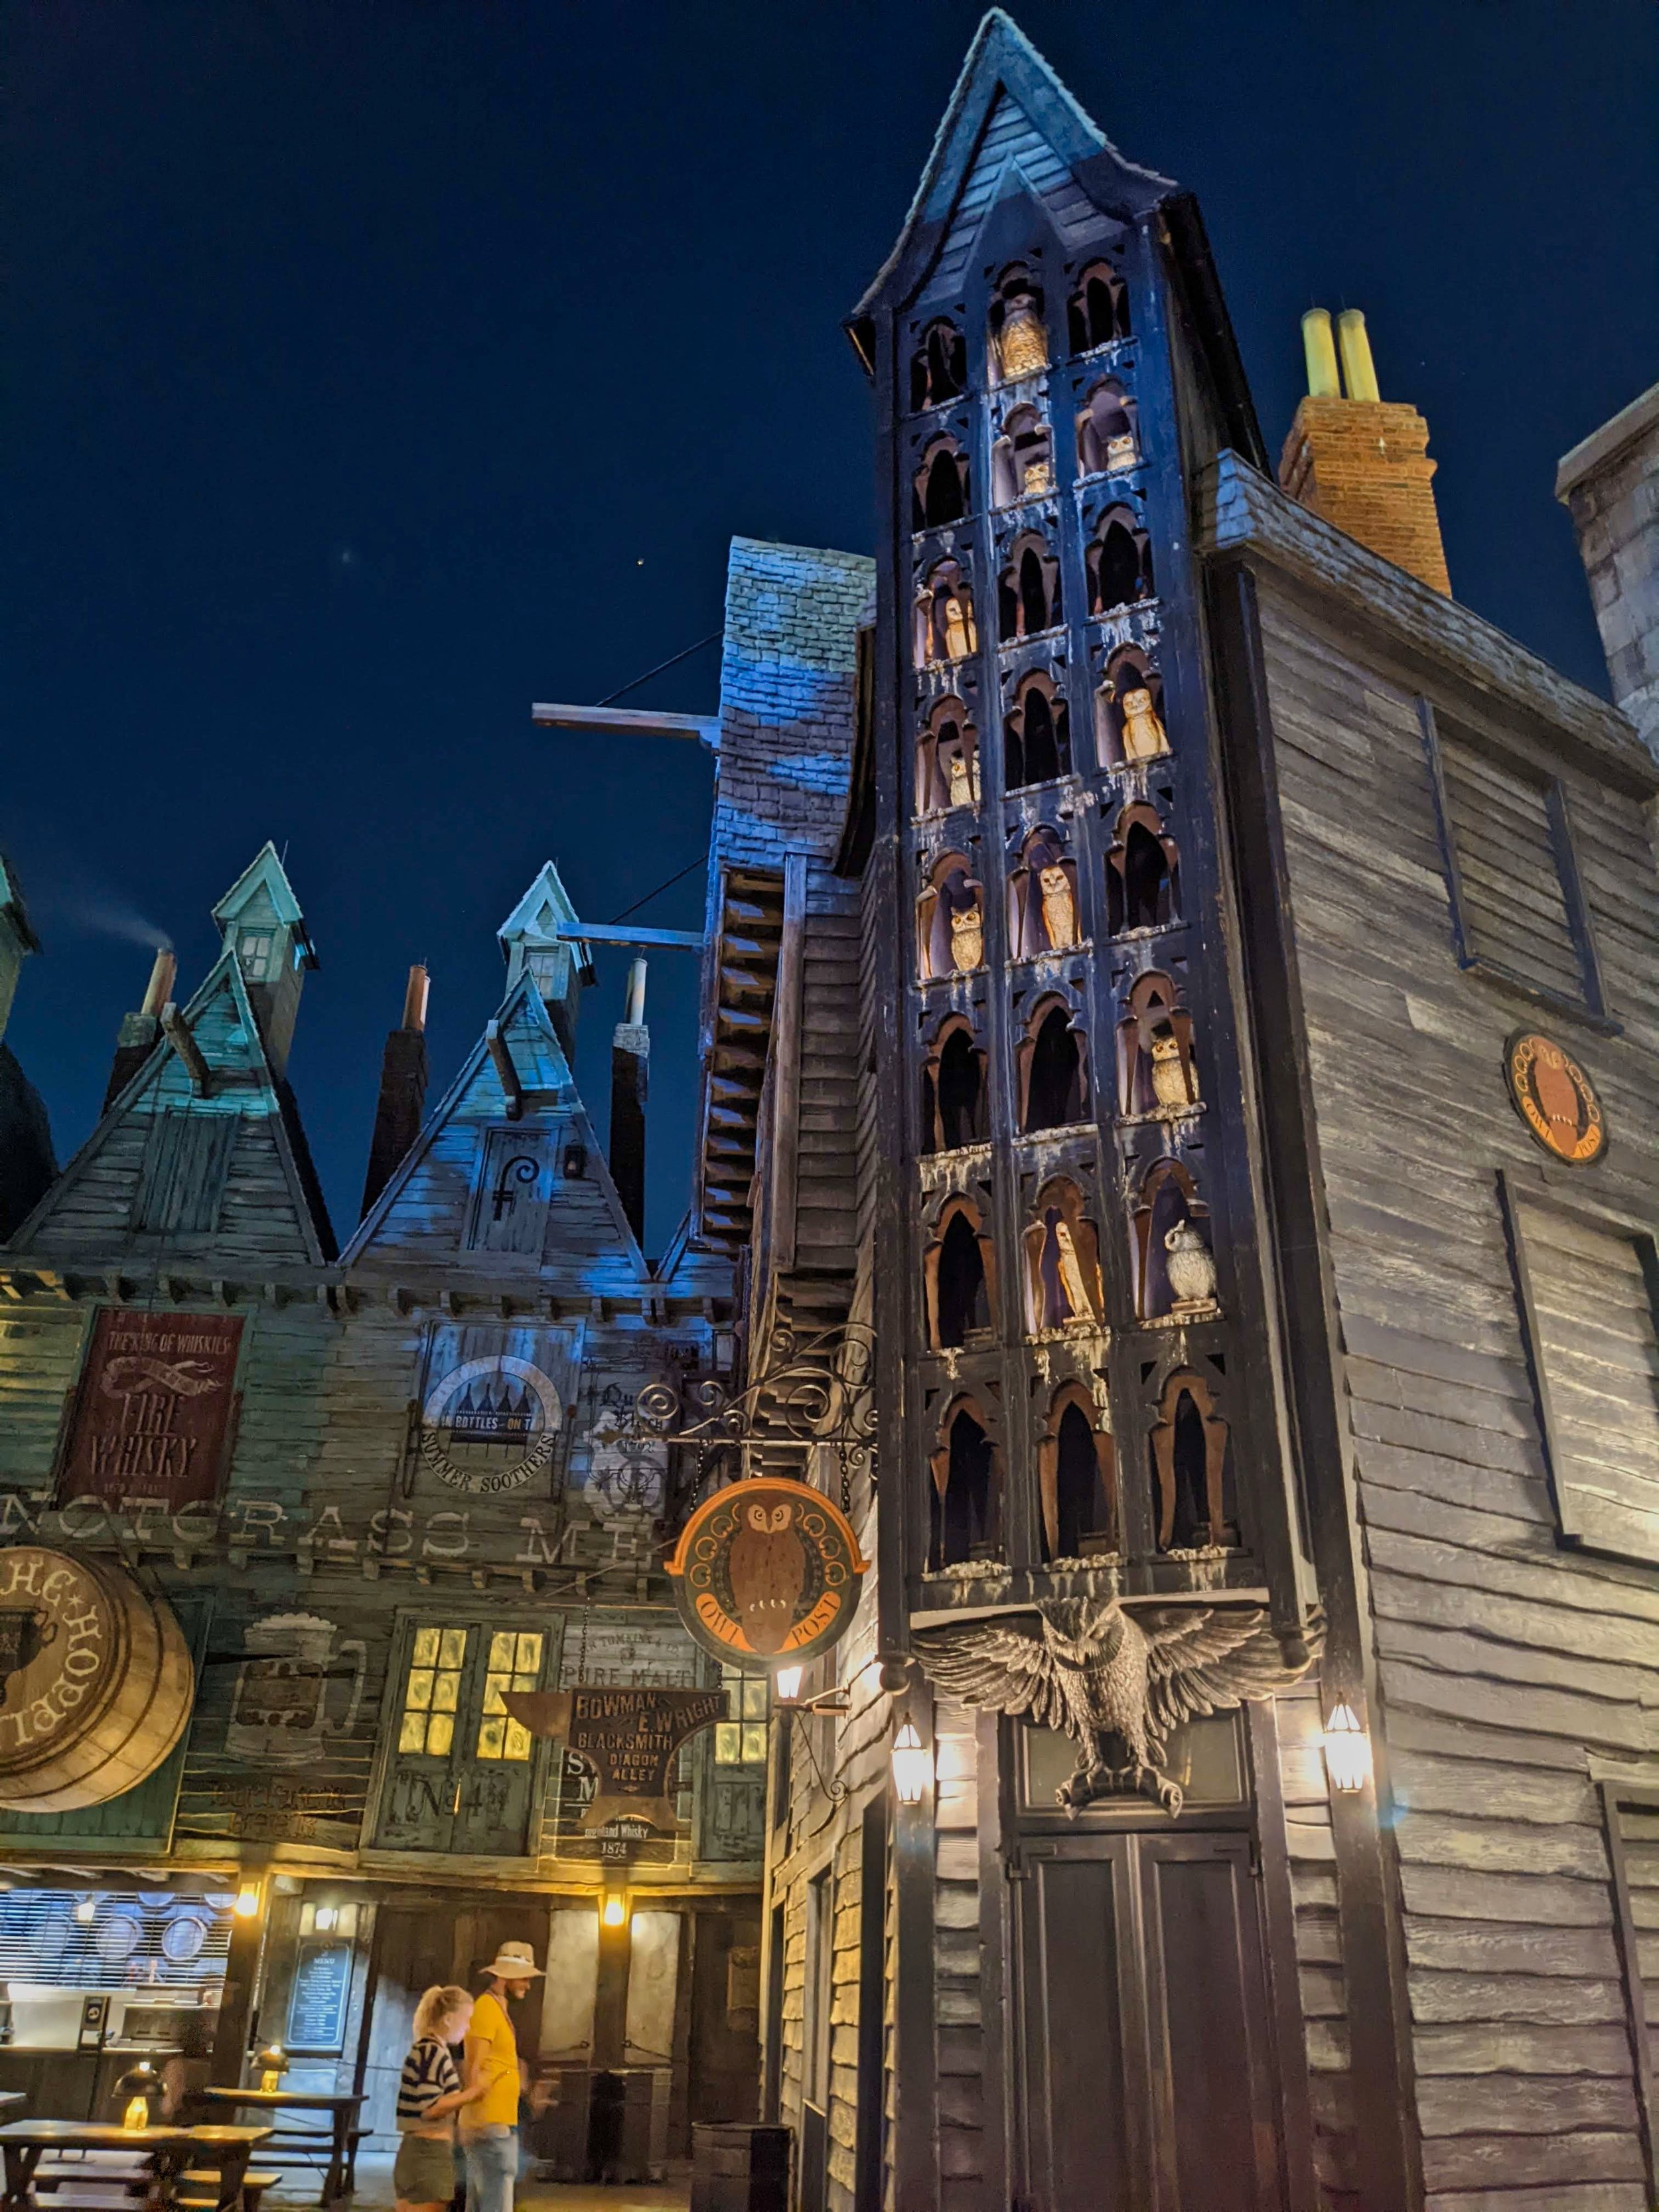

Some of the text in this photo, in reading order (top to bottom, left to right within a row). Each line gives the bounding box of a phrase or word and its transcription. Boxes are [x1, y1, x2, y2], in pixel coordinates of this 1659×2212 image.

[159, 1333, 175, 1353] OF
[455, 1415, 499, 1430] BOTTLES
[506, 1418, 522, 1431] ON
[421, 1430, 559, 1493] SUMMER SOOTHERS
[700, 1594, 838, 1646] OWL POST
[0, 1556, 102, 1747] HE HOPPI
[631, 1668, 691, 1688] MALT
[575, 1692, 656, 1720] BOWMAN
[578, 1732, 673, 1751] BLACKSMITH
[609, 1753, 659, 1767] DIAGON
[612, 1767, 656, 1782] ALLEY
[620, 1823, 648, 1840] Whisky
[601, 1841, 628, 1854] 1874
